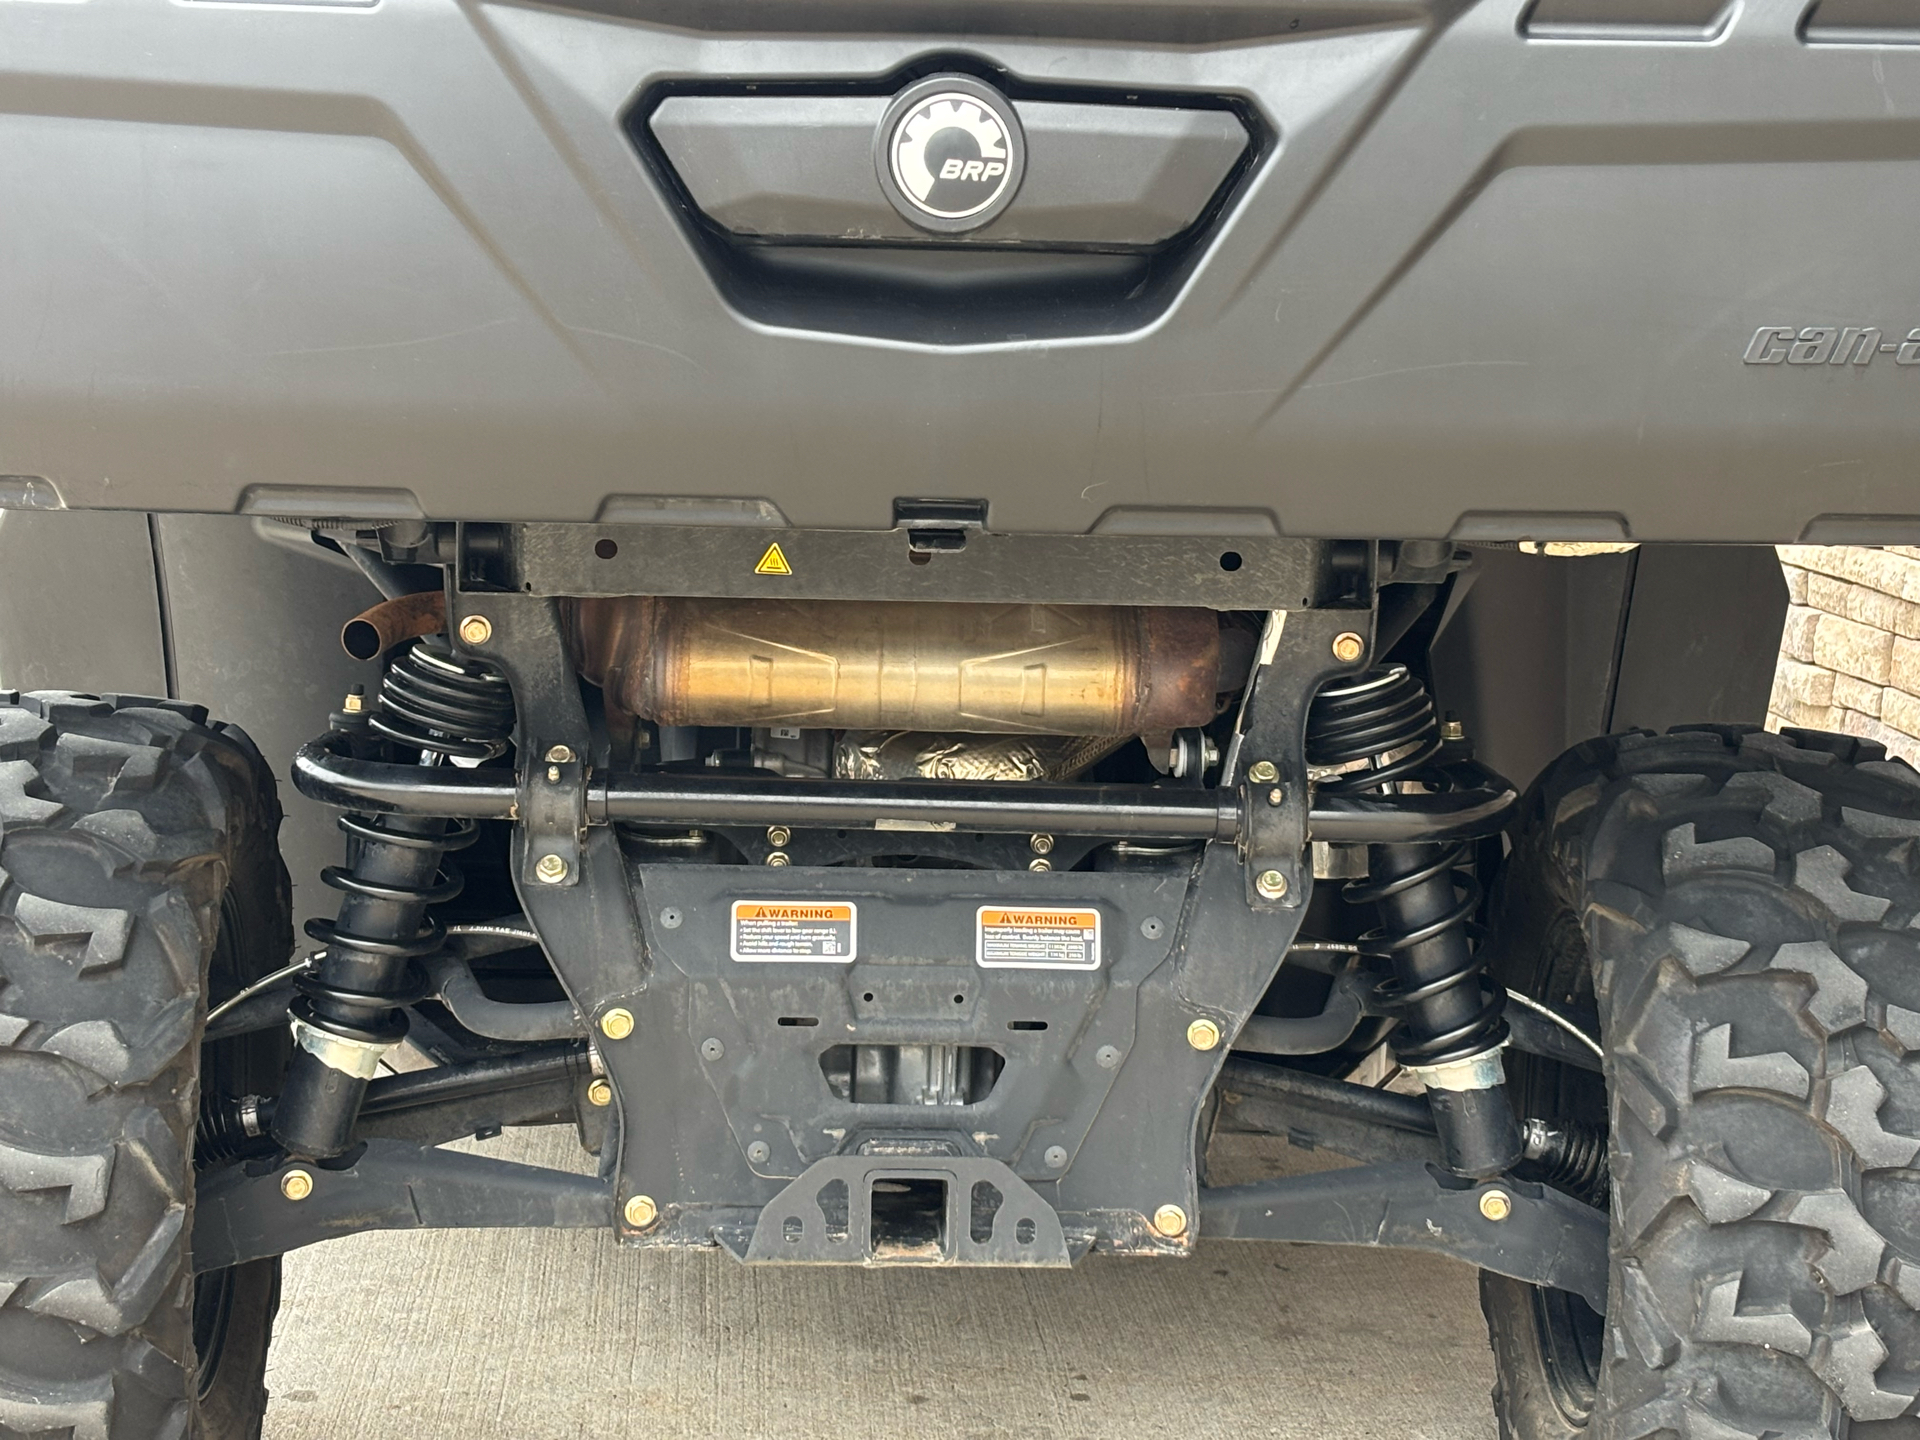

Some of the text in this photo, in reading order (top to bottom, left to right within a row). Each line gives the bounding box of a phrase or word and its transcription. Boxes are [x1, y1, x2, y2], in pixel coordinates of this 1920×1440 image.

[939, 159, 1004, 181] BRP
[769, 909, 833, 918] WARNING
[1013, 916, 1077, 925] WARNING
